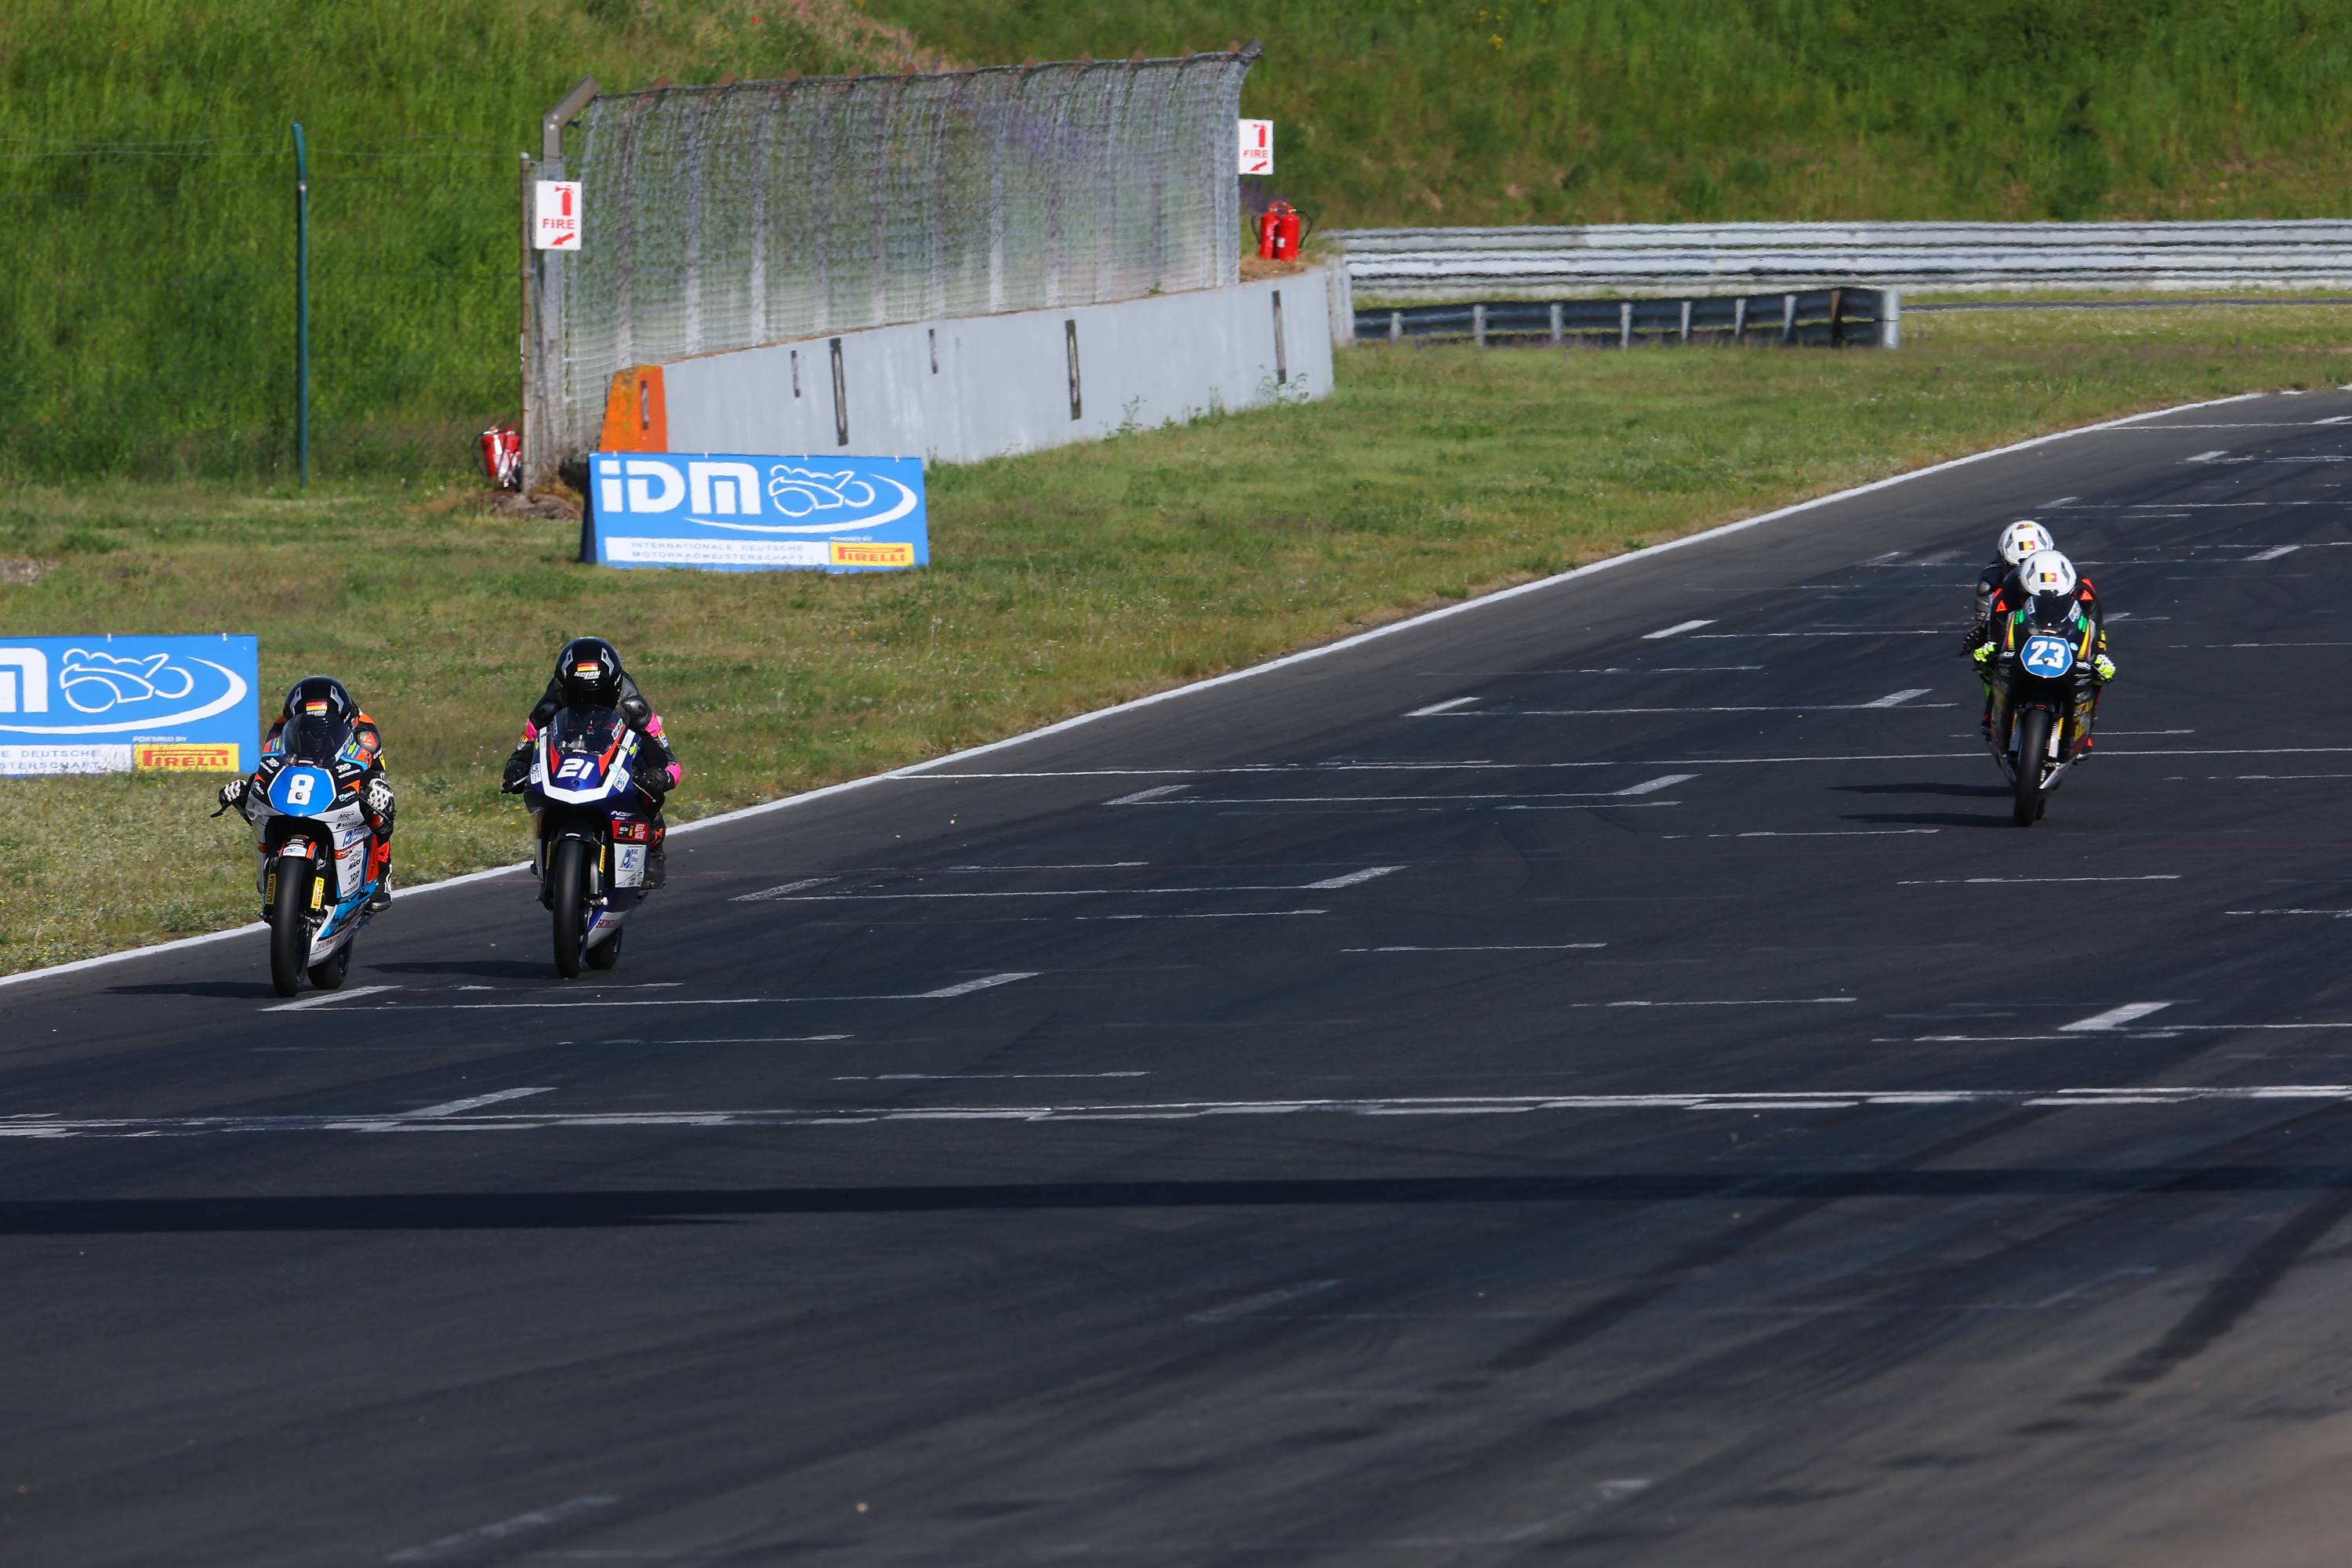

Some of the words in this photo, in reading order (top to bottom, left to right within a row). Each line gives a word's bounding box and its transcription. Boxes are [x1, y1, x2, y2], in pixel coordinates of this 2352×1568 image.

[543, 218, 575, 230] FIRE
[631, 542, 733, 550] INTERNATIONALE
[632, 551, 804, 561] MOTORRADMEISTERSCHAFT
[837, 546, 906, 561] PIRELLI
[2027, 641, 2065, 669] 23
[573, 670, 601, 681] NOLAN
[143, 750, 229, 767] PIRELLI
[266, 757, 280, 768] JRP
[336, 763, 352, 773] JRP
[557, 758, 595, 780] 21
[286, 774, 315, 805] 8
[348, 870, 360, 885] JRP
